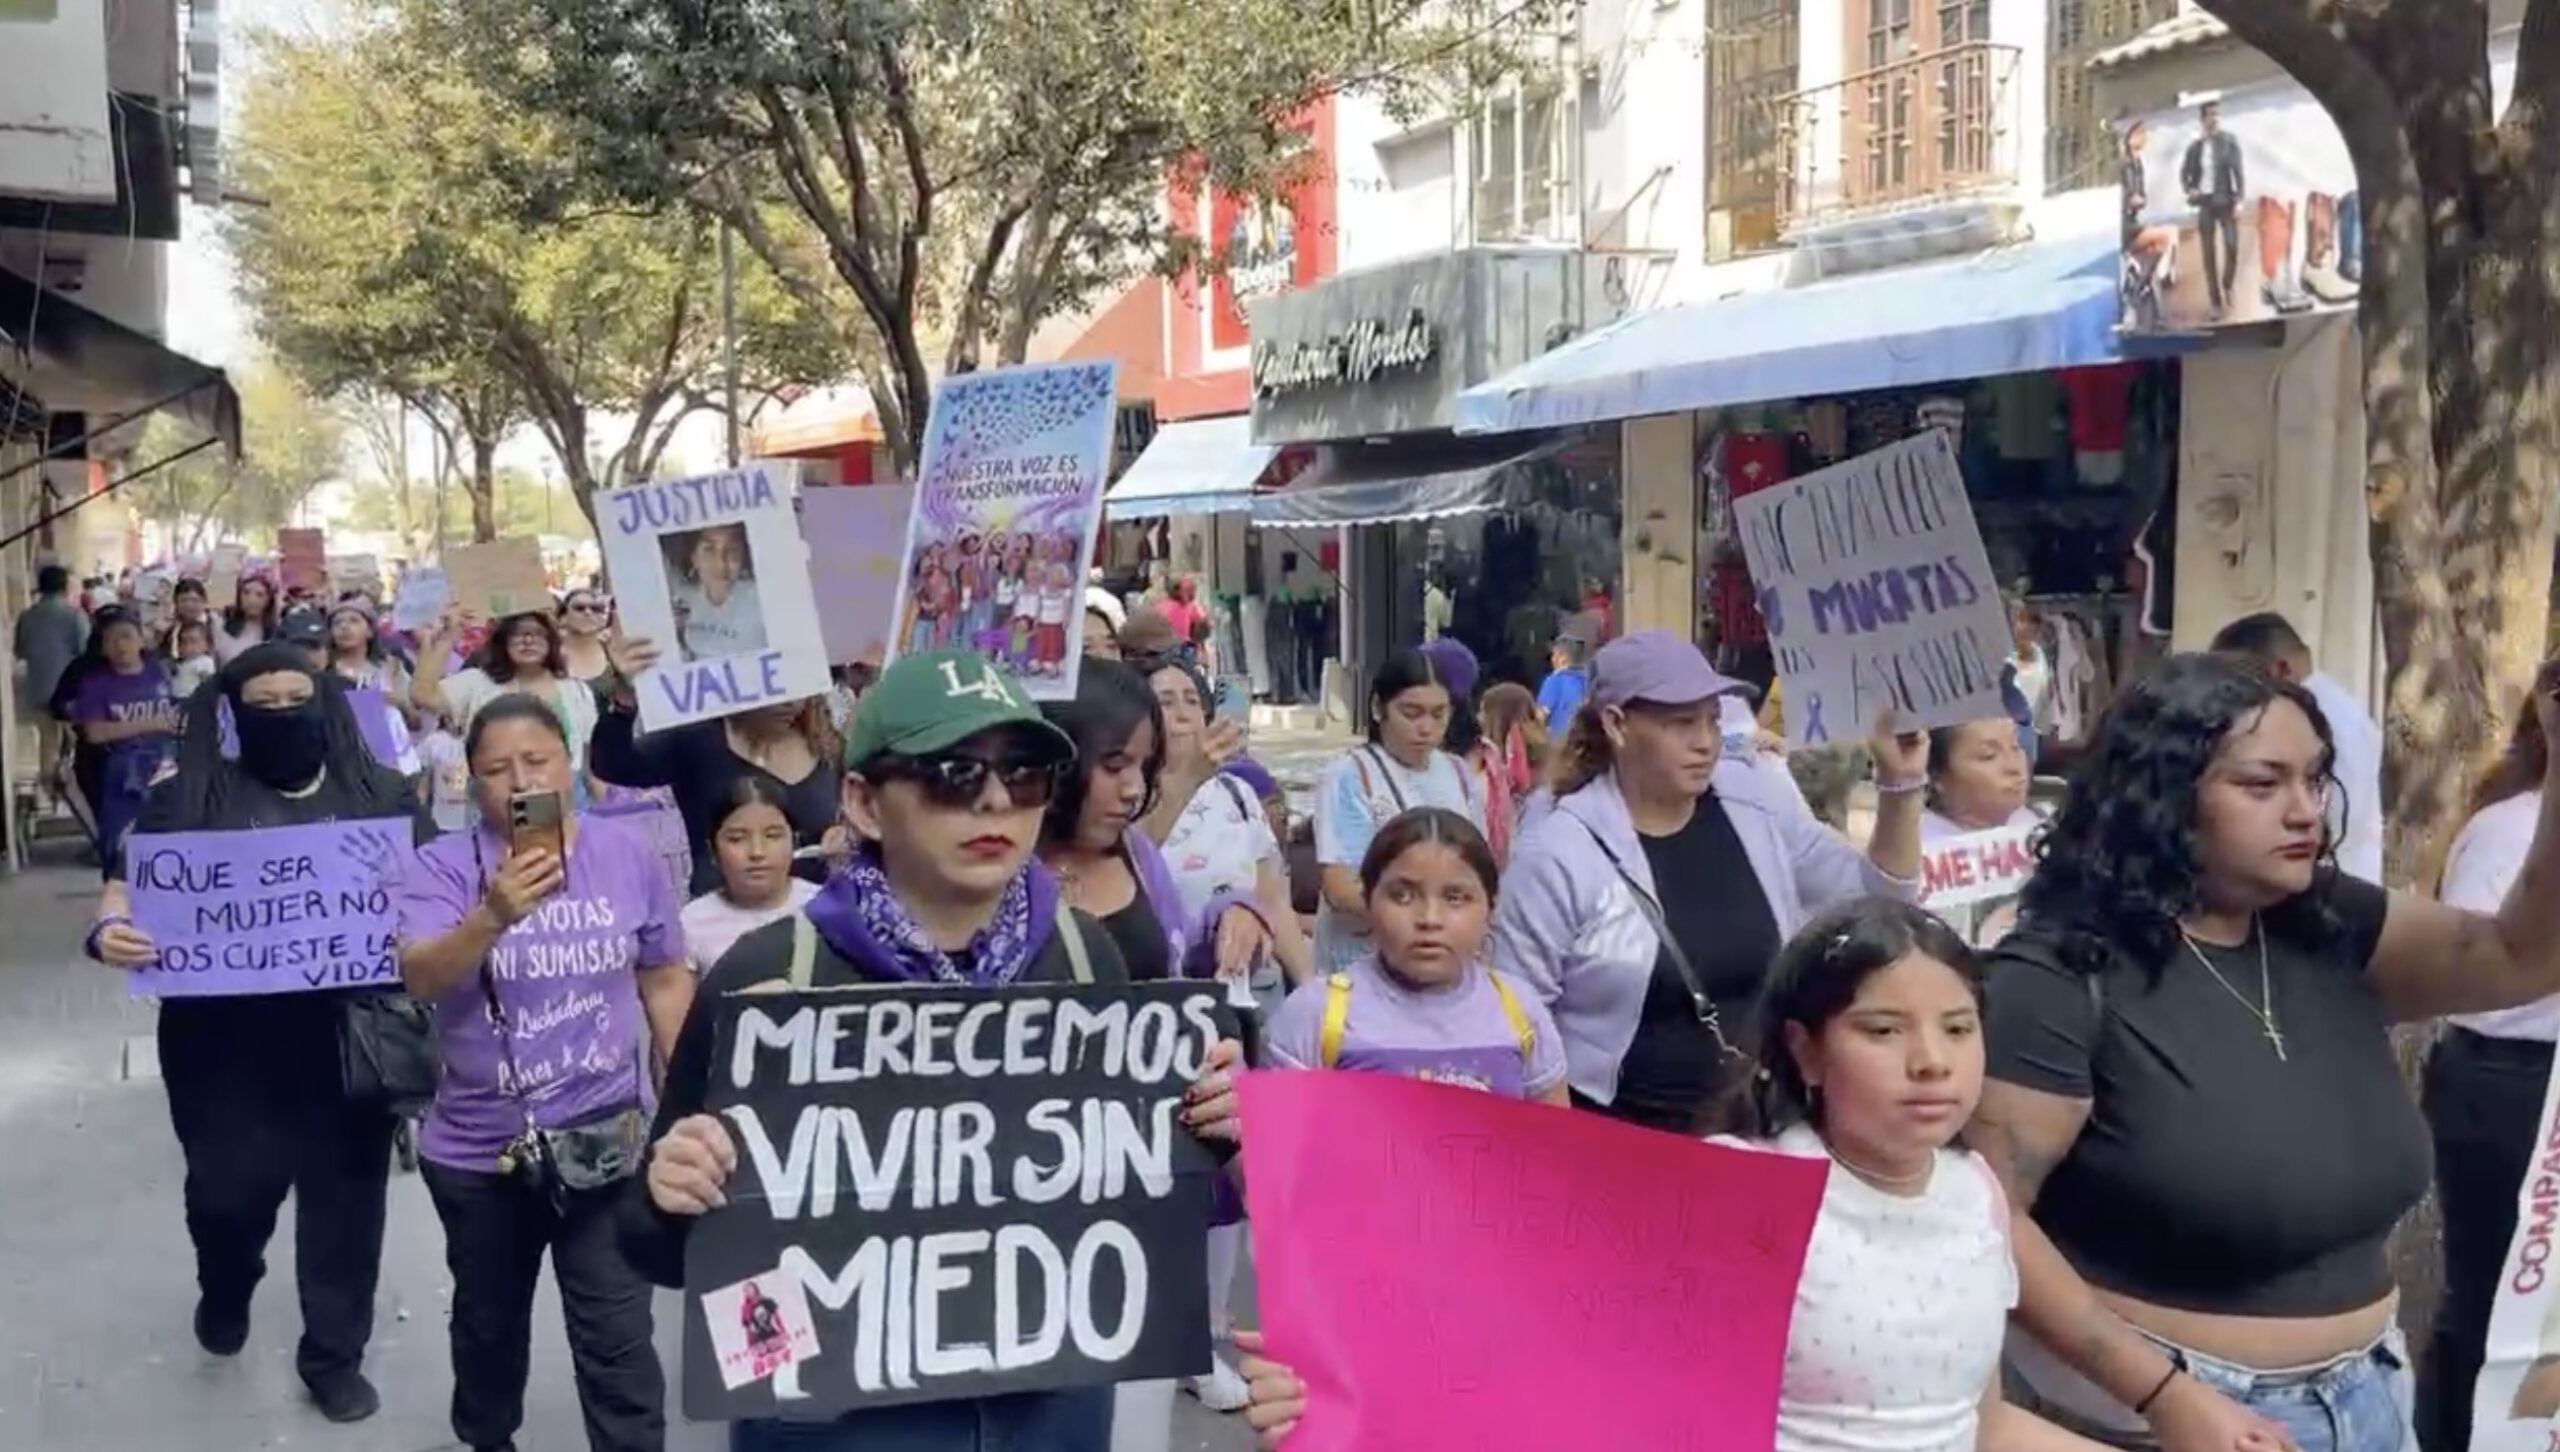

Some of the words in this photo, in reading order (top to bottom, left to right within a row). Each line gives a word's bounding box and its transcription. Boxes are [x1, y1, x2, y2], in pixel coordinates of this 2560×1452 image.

[938, 474, 1083, 500] TRANSFORMACIÓN
[945, 459, 1013, 482] NUESTRA
[1021, 456, 1053, 475] VOZ
[1057, 453, 1079, 473] ES
[613, 469, 776, 535] JUSTICIA
[660, 653, 786, 714] VALE
[938, 659, 1019, 708] LA
[259, 855, 319, 886] SER
[196, 889, 329, 934] MUJER
[341, 888, 390, 916] NO
[223, 934, 349, 971] CUESTE
[367, 933, 398, 956] LA
[303, 954, 396, 987] VIDA
[492, 946, 517, 980] NI
[527, 936, 627, 979] SUMISAS
[731, 994, 1219, 1088] MERECEMOS
[721, 1101, 1008, 1219] VIVIR
[1013, 1096, 1182, 1204] SIN
[772, 1219, 1149, 1400] MIEDO
